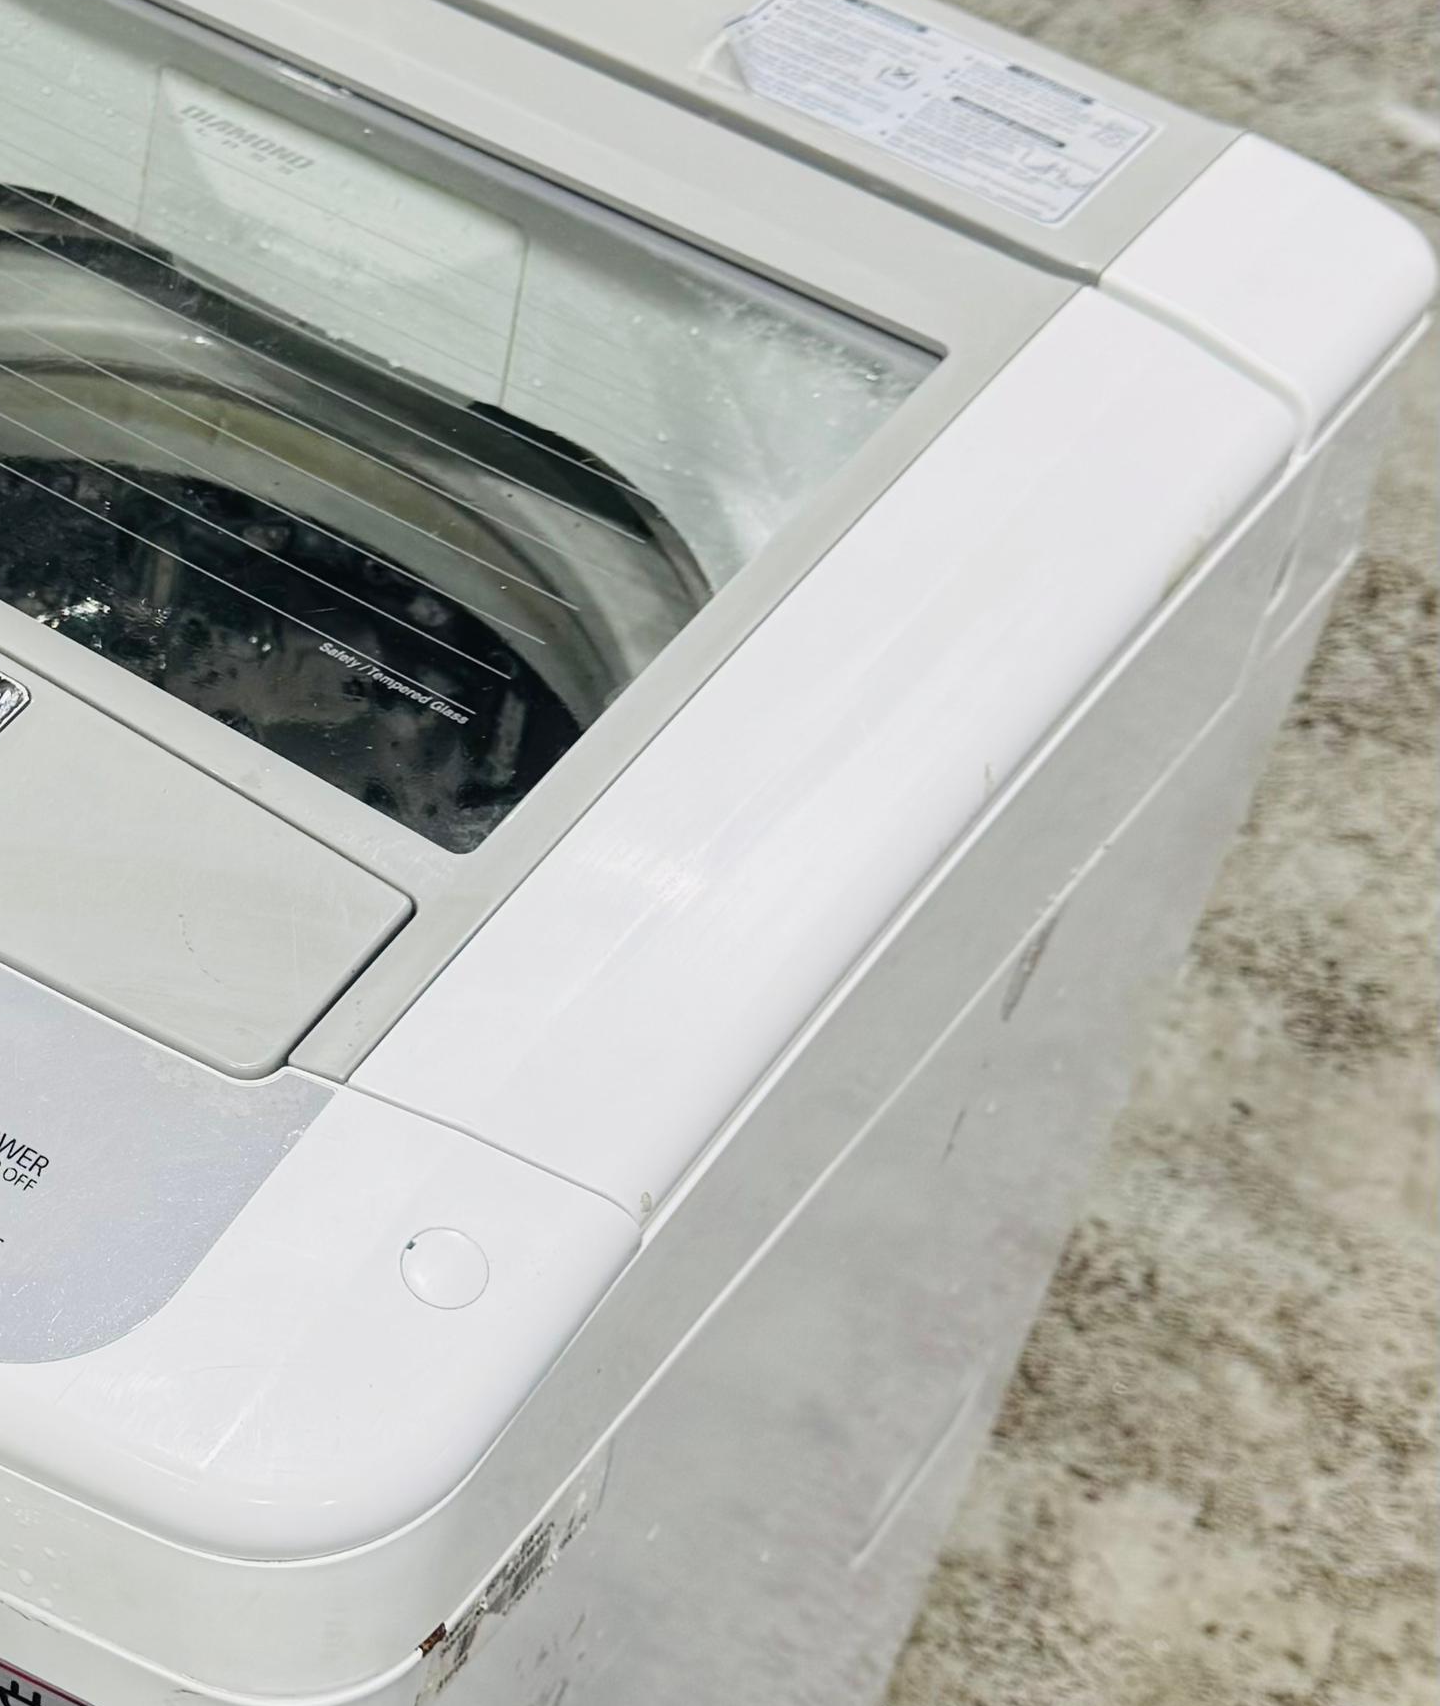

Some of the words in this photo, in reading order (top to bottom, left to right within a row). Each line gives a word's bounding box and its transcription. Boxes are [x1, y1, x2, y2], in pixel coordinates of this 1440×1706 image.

[319, 642, 361, 668] Safety
[367, 666, 433, 704] Tempered
[429, 700, 469, 725] Glass
[0, 1165, 38, 1192] OFF
